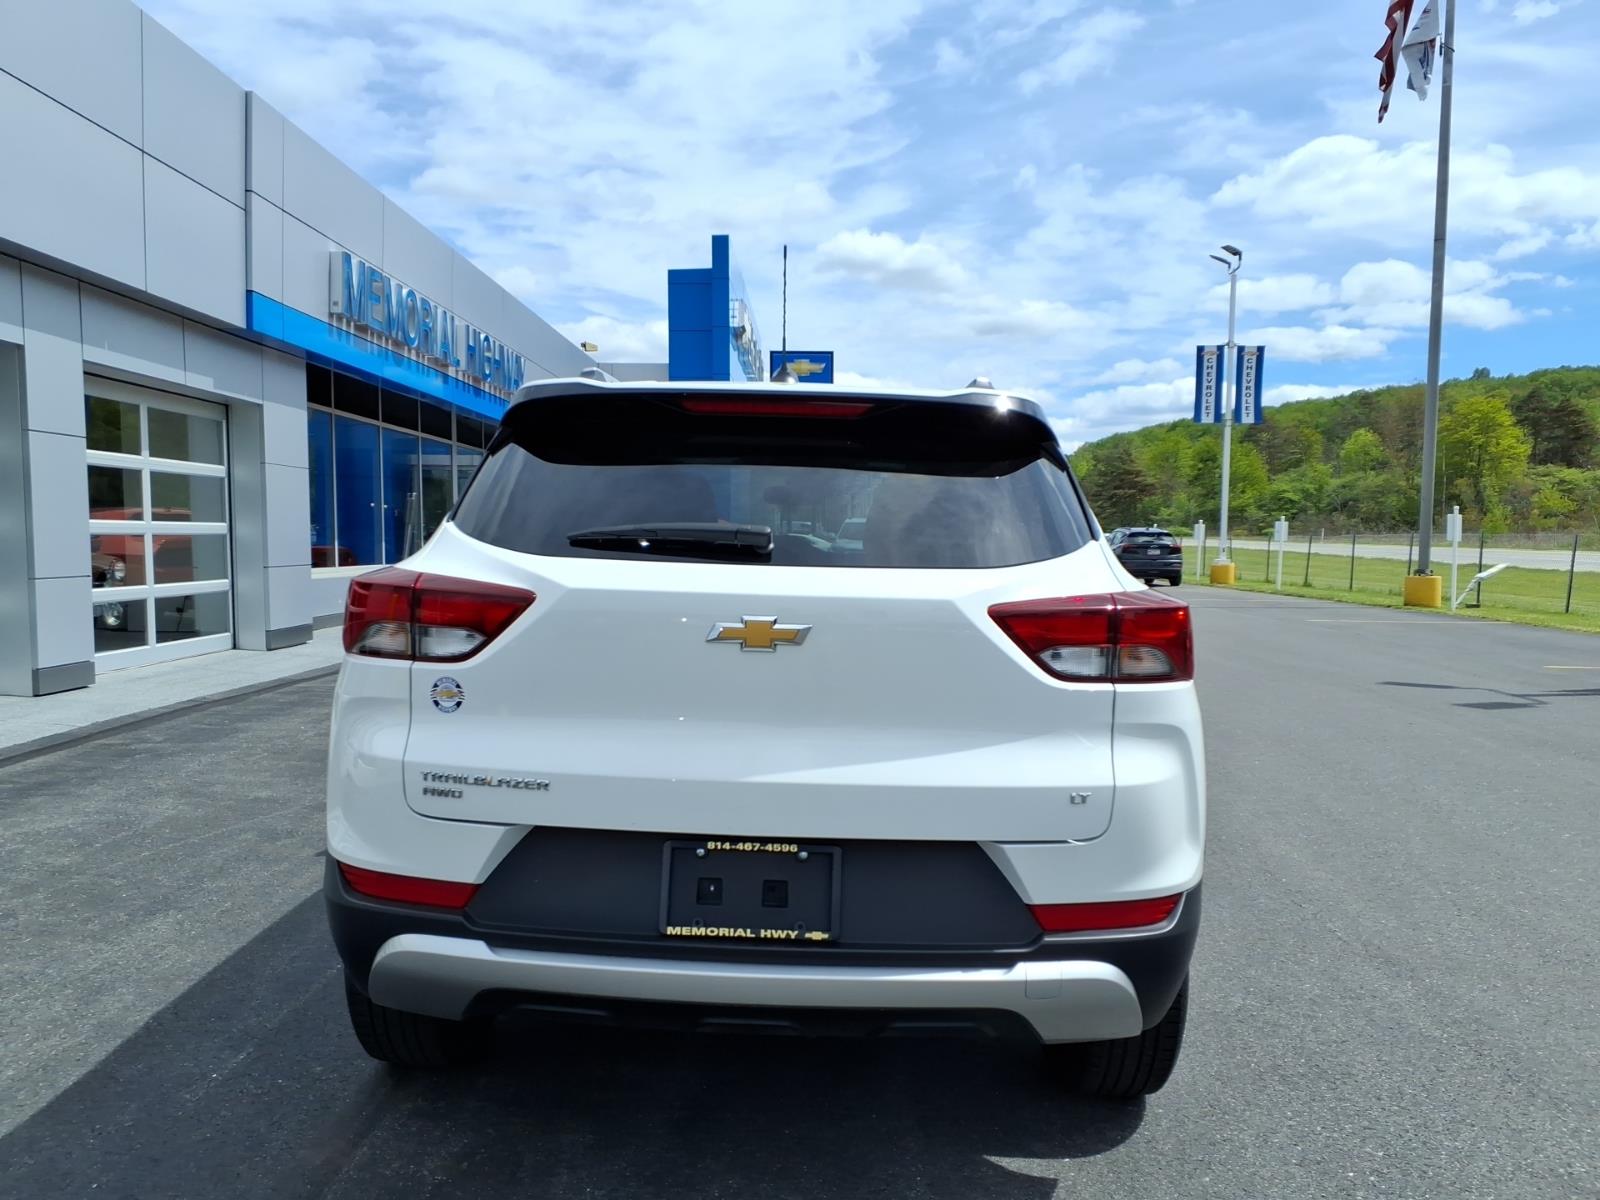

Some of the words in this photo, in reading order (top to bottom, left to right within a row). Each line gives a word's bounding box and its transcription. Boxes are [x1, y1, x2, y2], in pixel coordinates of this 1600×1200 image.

[334, 250, 461, 368] MEMORIAL
[1205, 357, 1214, 418] CHEVROLET
[1244, 357, 1253, 418] CHEVROLET
[422, 771, 550, 791] TRAILBLAZER
[422, 787, 463, 799] AWD
[1070, 792, 1092, 805] LT
[706, 841, 798, 852] 814-467-4596
[666, 926, 755, 938] MEMORIAL
[760, 929, 798, 939] HWY
